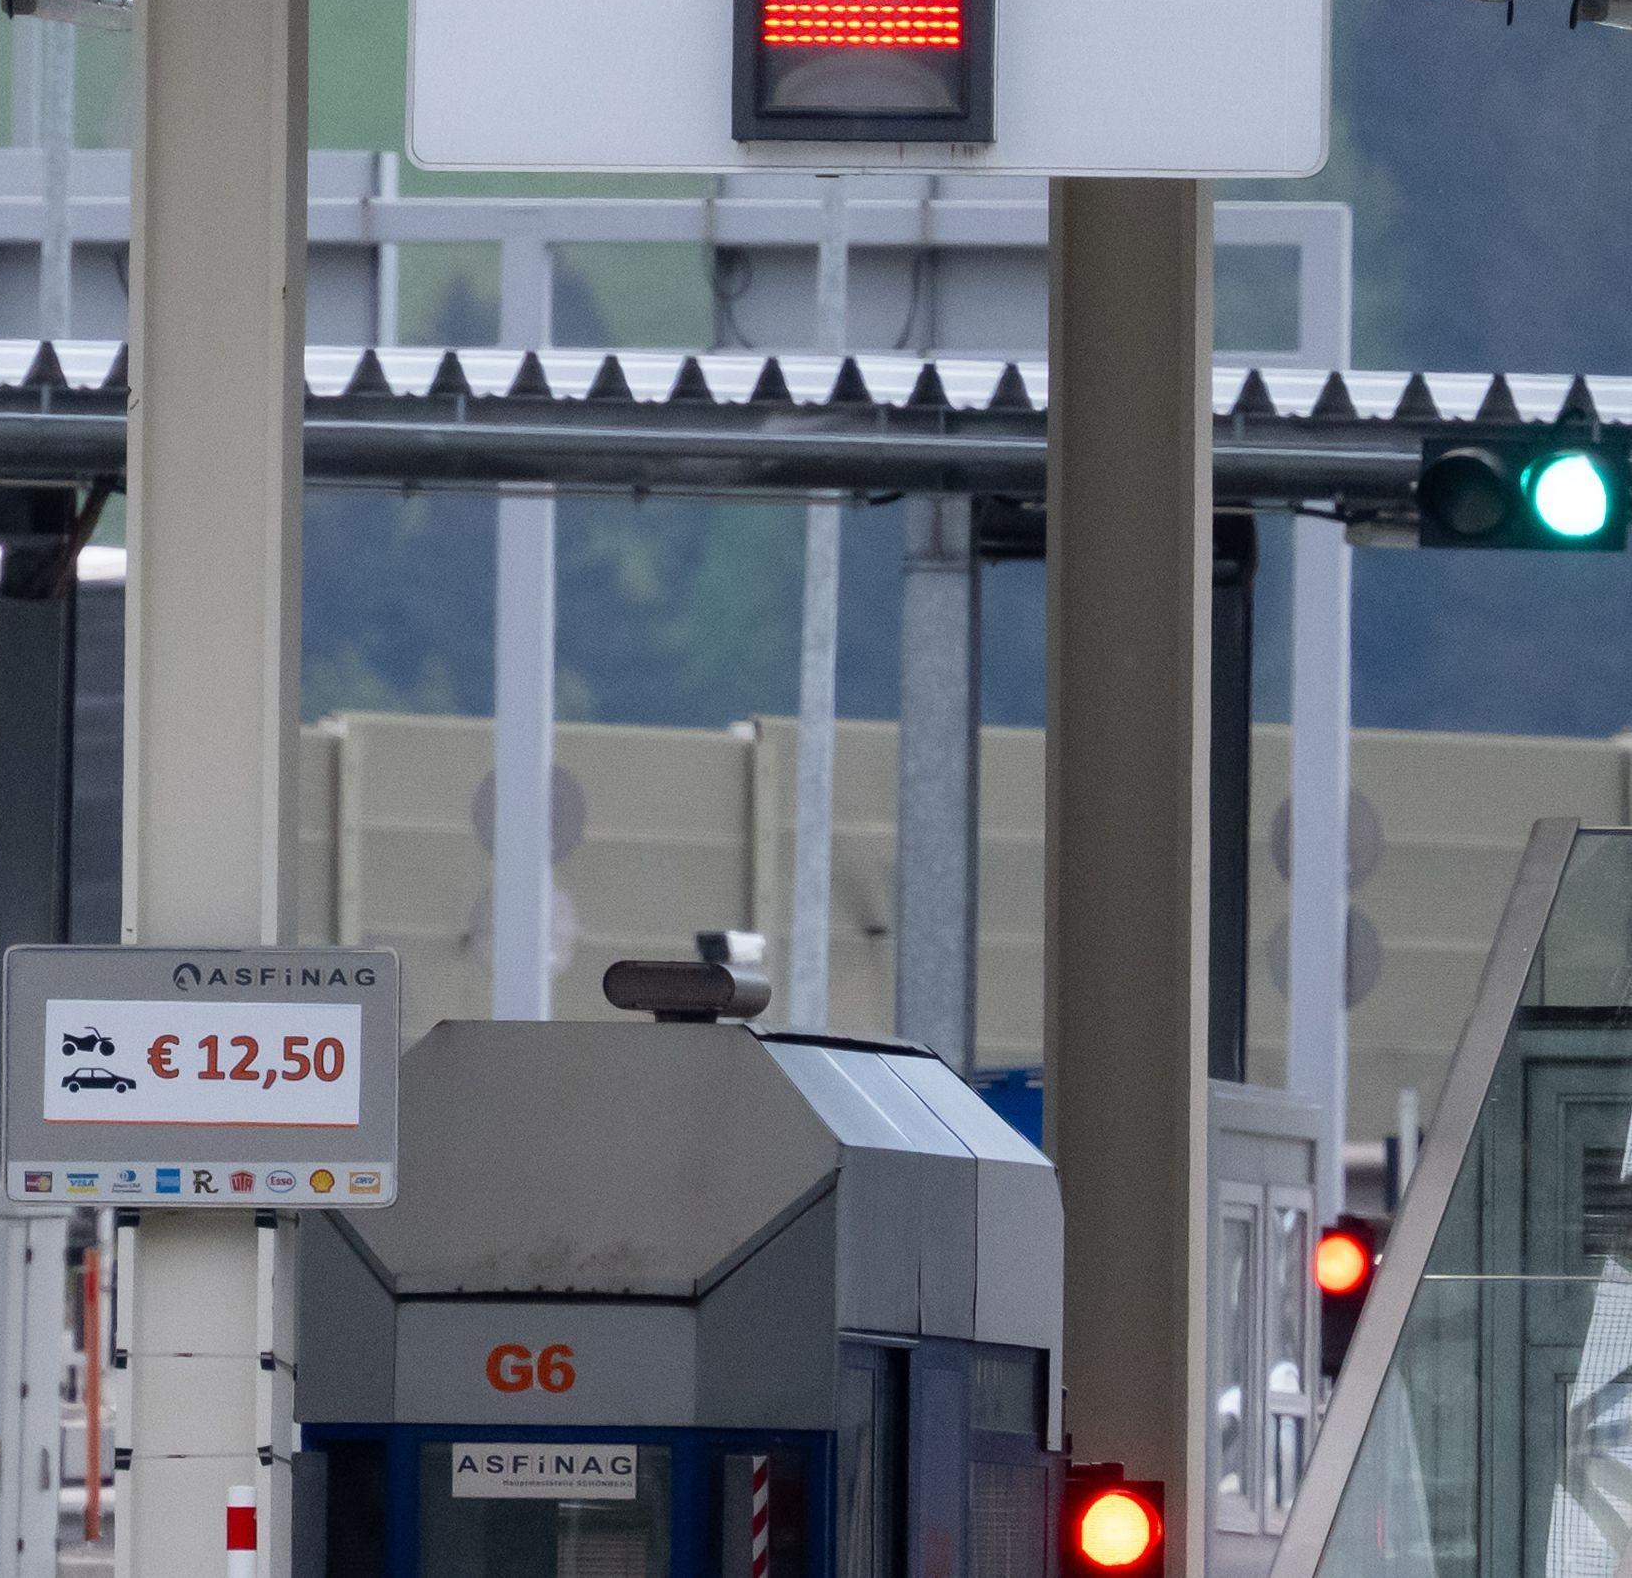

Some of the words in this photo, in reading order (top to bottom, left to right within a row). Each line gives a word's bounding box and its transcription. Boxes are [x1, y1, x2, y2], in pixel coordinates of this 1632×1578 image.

[147, 1034, 180, 1080] €
[198, 1034, 345, 1090] 12,50
[485, 1344, 577, 1393] G6
